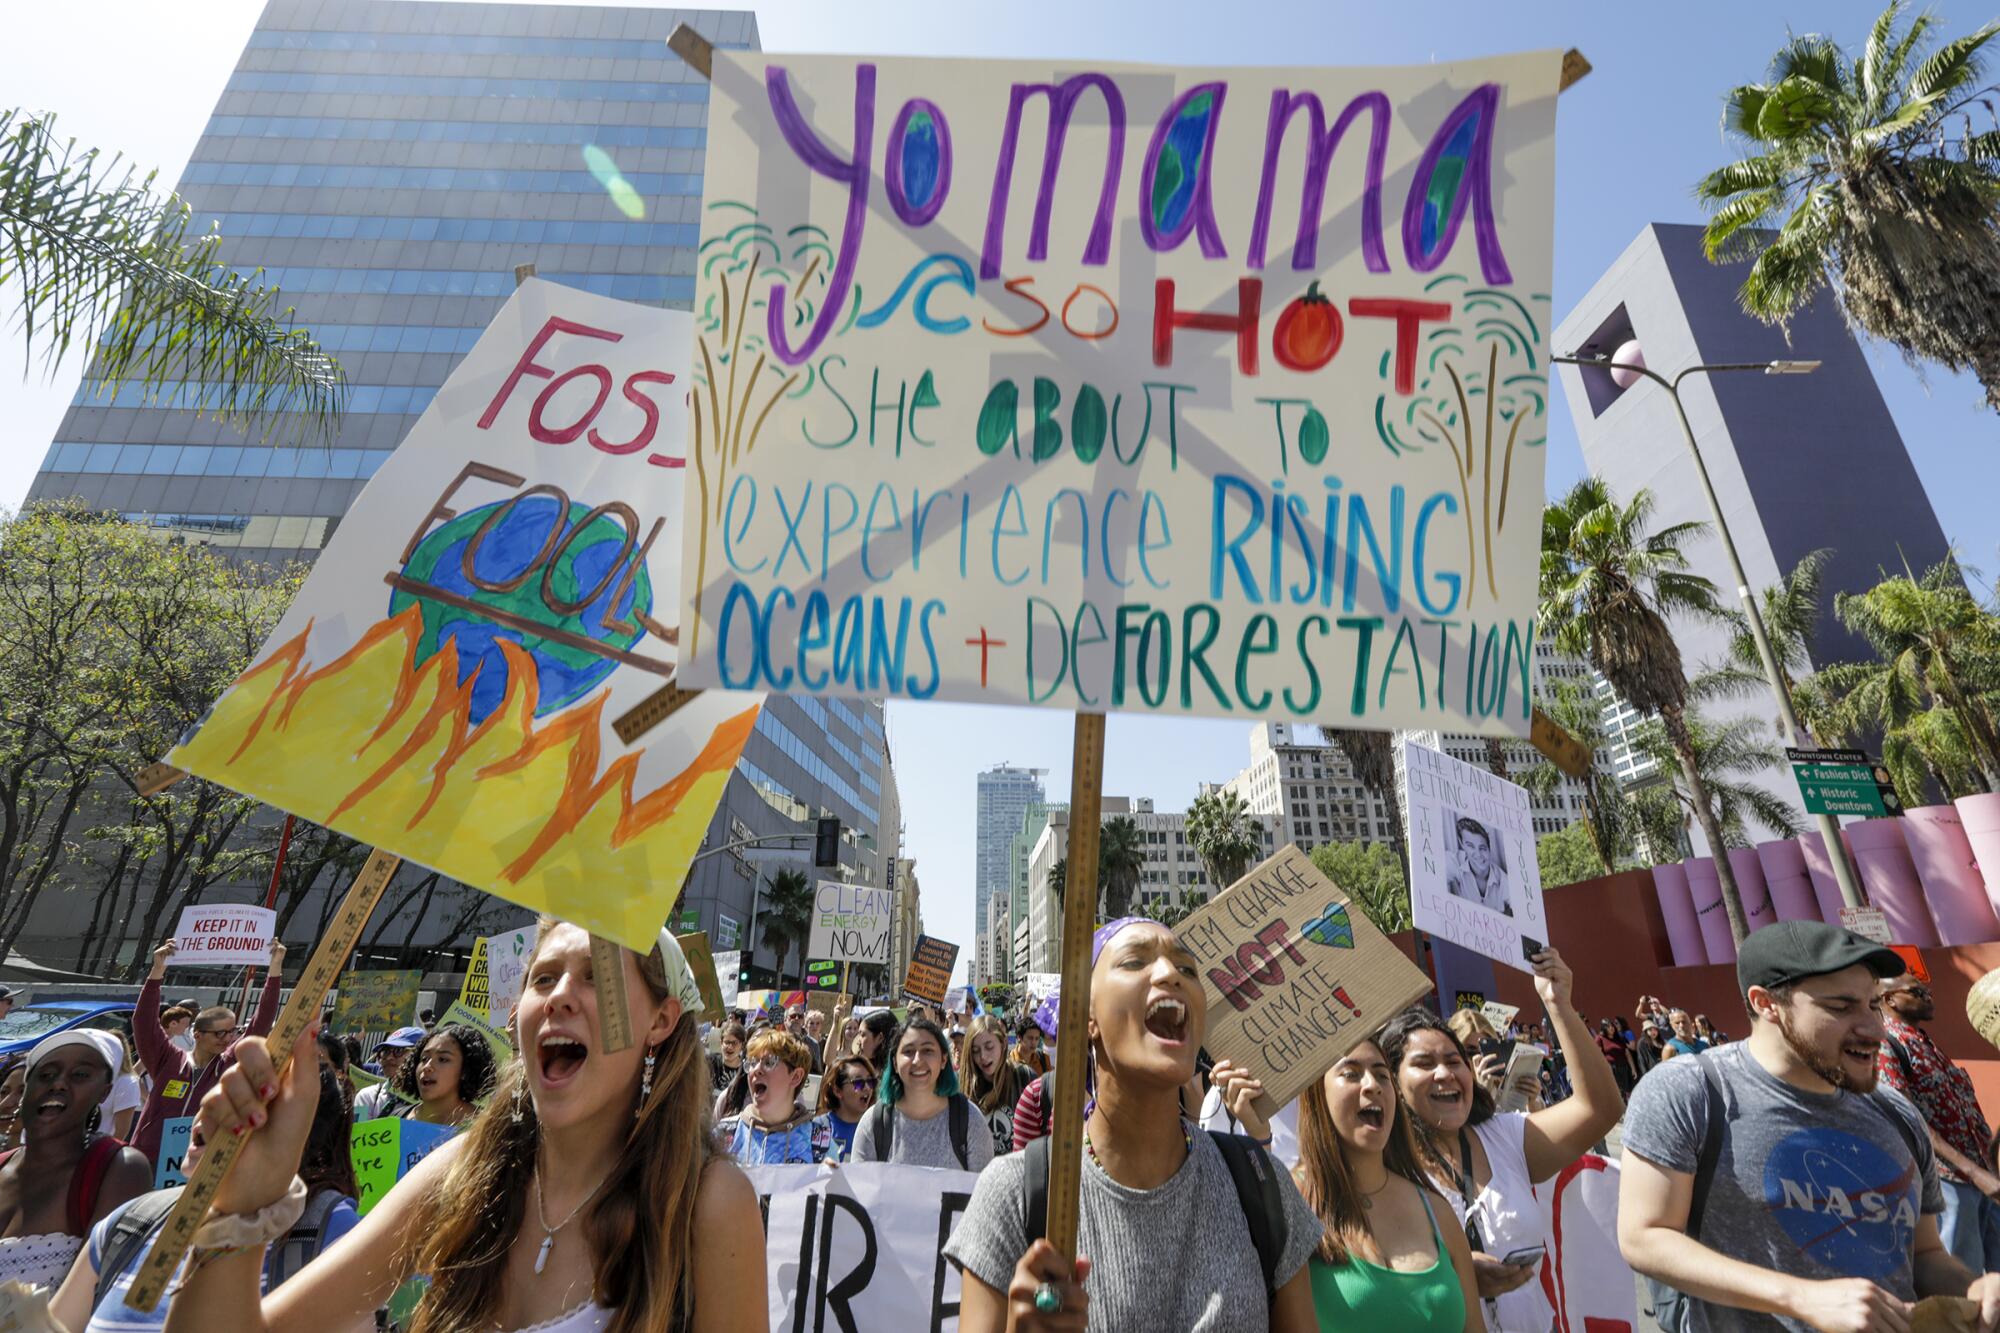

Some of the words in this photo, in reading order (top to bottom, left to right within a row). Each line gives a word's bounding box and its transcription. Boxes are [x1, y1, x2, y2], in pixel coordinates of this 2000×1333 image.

[1152, 276, 1452, 396] HOT
[477, 316, 686, 468] FOS
[1408, 743, 1448, 777] THE
[1452, 757, 1505, 802] PLANET
[1408, 767, 1468, 811] GETTING
[1813, 768, 1850, 780] Fashion
[1850, 769, 1872, 781] Dist
[1820, 787, 1859, 799] Historic
[1824, 799, 1874, 812] Downtown
[816, 885, 891, 916] CLEAN
[1226, 857, 1319, 929] CHANGE
[193, 919, 228, 933] KEEP
[229, 919, 244, 933] IT
[244, 920, 258, 934] IN
[820, 914, 878, 931] ENERGY
[178, 936, 206, 951] THE
[207, 936, 265, 952] GROUND!
[829, 929, 888, 961] NOW!
[1206, 917, 1308, 1013] NOT
[454, 1006, 472, 1022] FOOD
[475, 1019, 495, 1036] WATER
[1241, 959, 1341, 1045] CLIMATE
[1262, 985, 1362, 1074] CHANGE!
[1779, 1177, 1916, 1229] NASA
